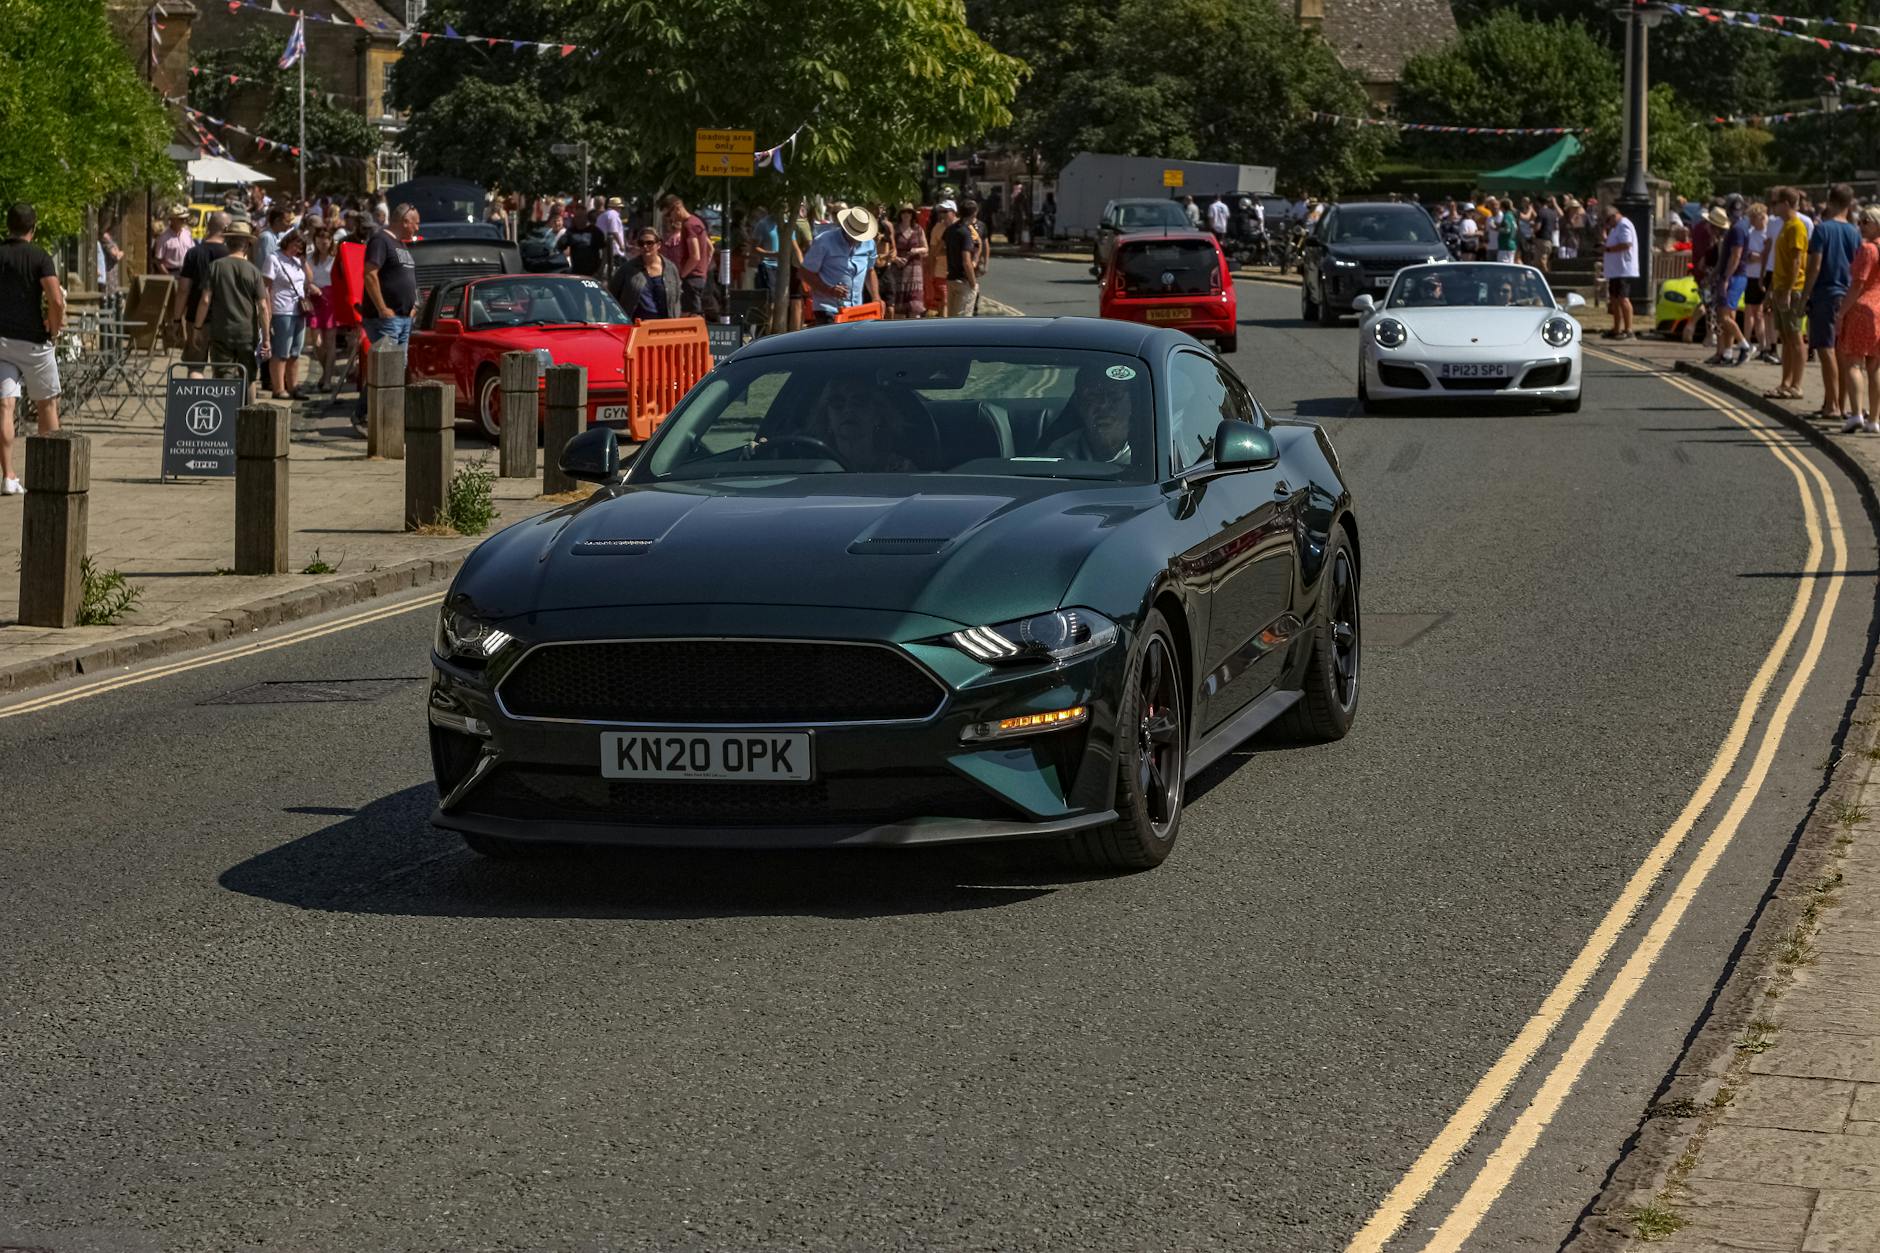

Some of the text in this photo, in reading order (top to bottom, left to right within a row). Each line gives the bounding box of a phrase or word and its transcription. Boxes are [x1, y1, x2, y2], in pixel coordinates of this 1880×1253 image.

[714, 142, 735, 151] only
[700, 164, 709, 172] At
[731, 164, 750, 172] time
[1481, 364, 1504, 377] SPG
[176, 385, 236, 398] ANTIQUES
[603, 407, 629, 419] GYN
[176, 440, 228, 448] CHELTENHAM
[197, 448, 235, 457] ANTIQUES
[193, 460, 218, 469] OPEN
[617, 737, 793, 773] KN20 OPK
